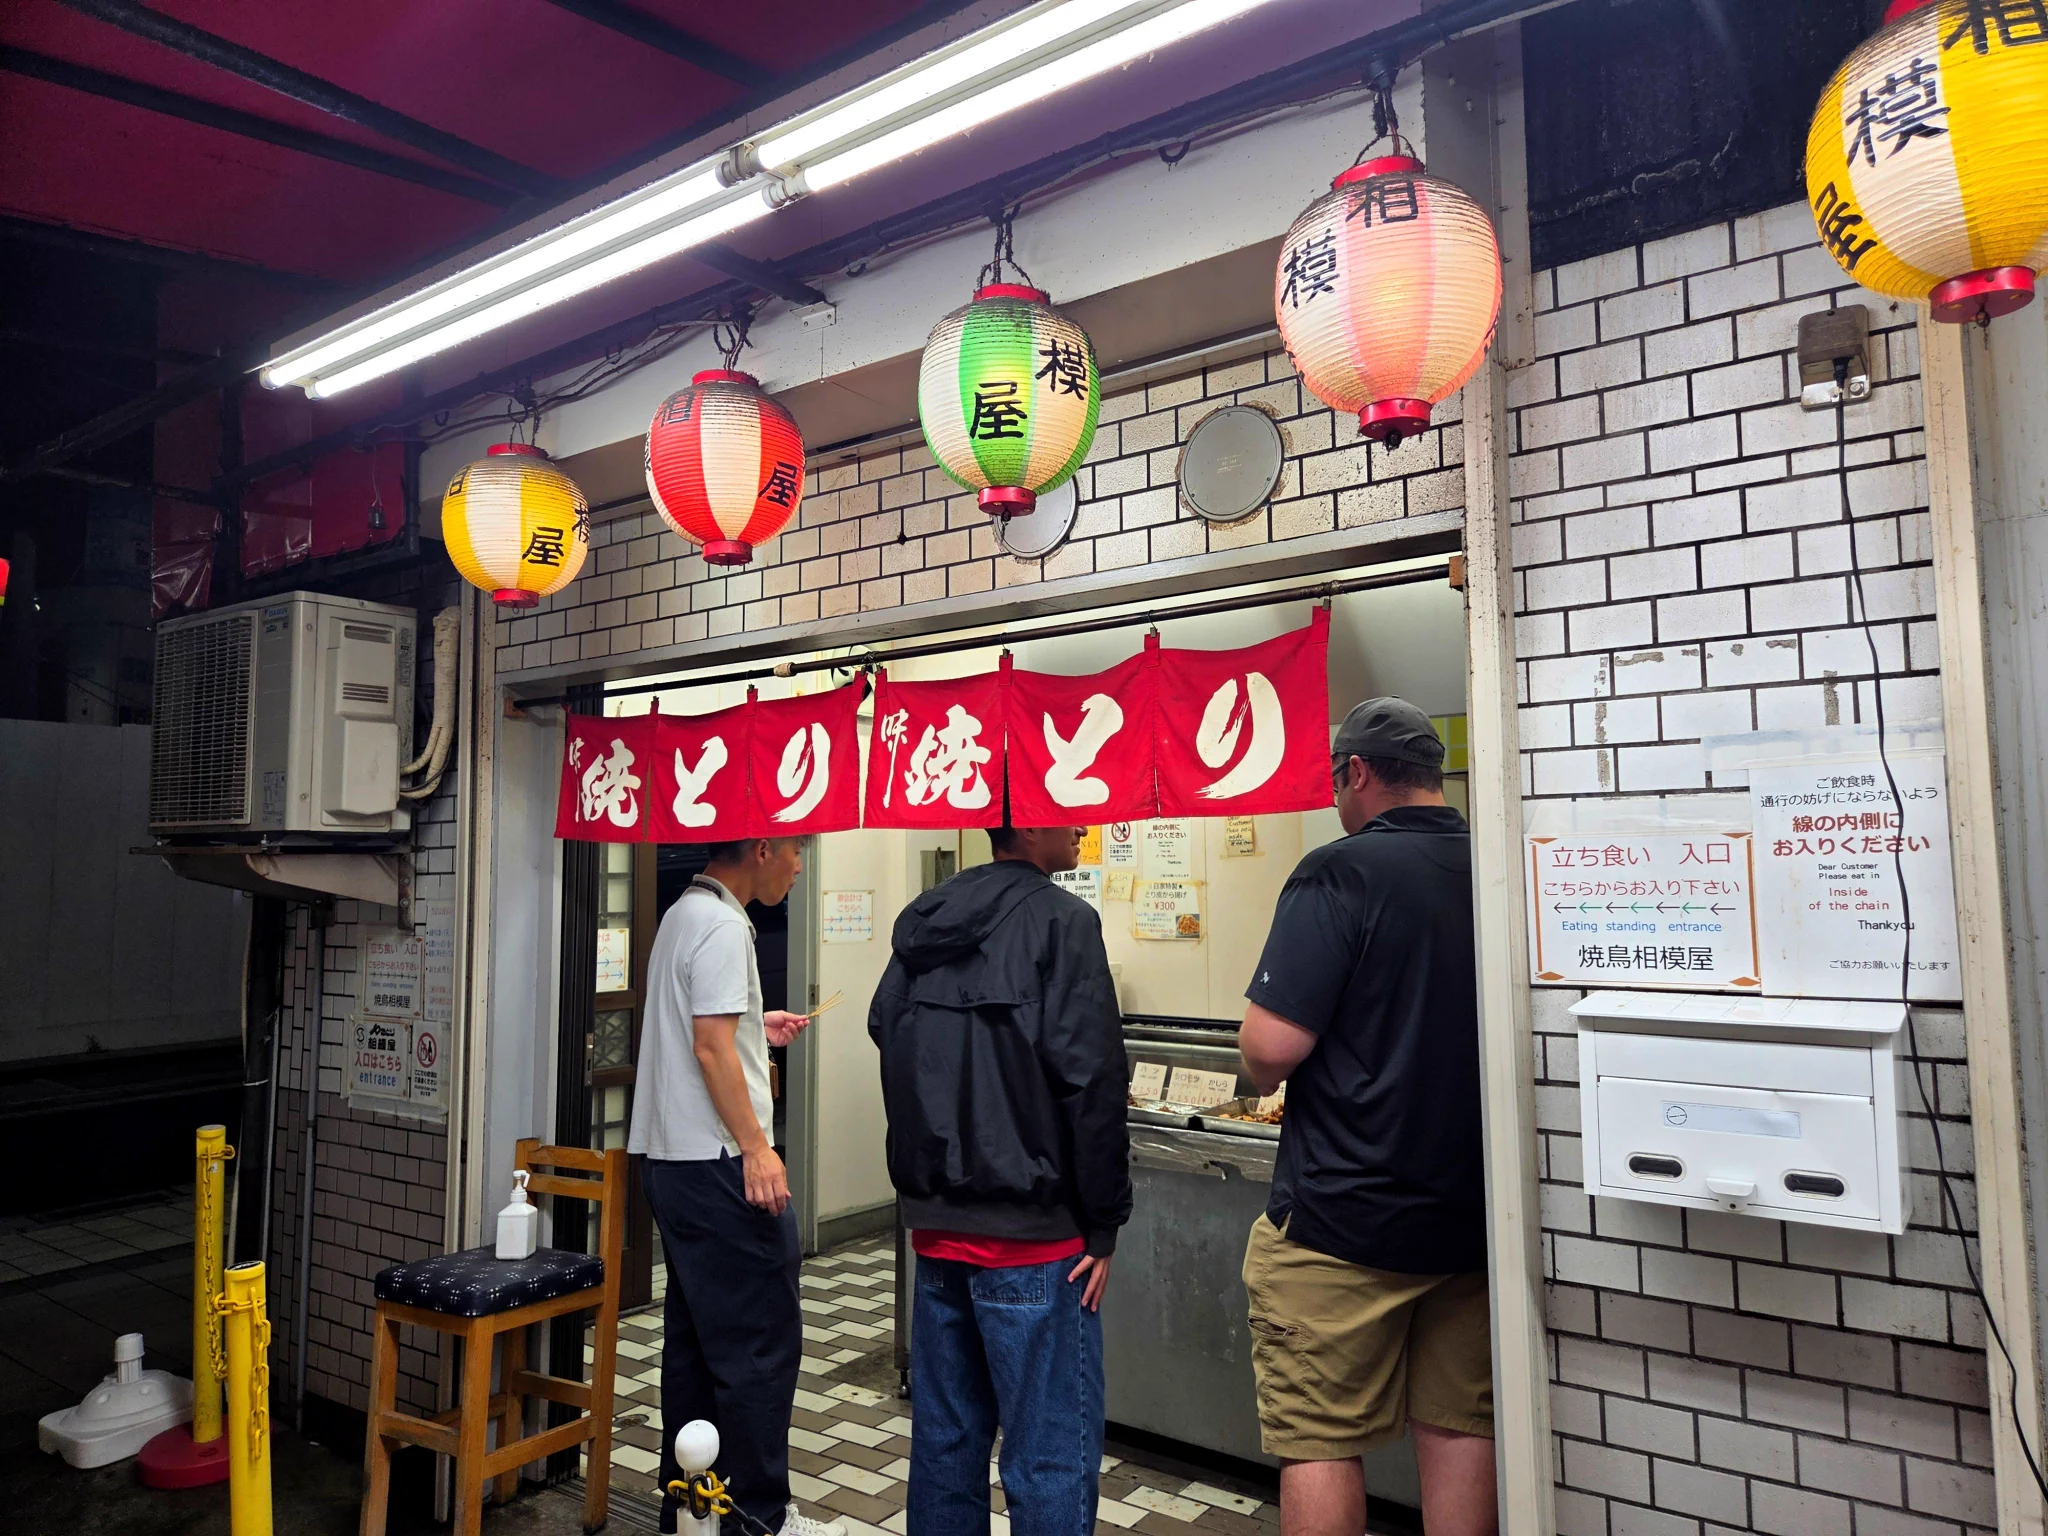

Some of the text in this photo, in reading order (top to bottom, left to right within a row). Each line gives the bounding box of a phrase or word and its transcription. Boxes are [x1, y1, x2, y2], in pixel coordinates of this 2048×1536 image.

[1816, 775, 1876, 789] ご飲食時
[1792, 811, 1903, 833] 線の内側に
[1773, 835, 1931, 857] お入りください
[1552, 843, 1731, 868] 立ち食い 入口
[1544, 879, 1740, 896] こちらからお入り下さい
[1829, 887, 1868, 897] Inside
[1808, 901, 1890, 910] of the chain
[1562, 921, 1722, 933] Eating standing entrance
[1578, 944, 1714, 971] 焼鳥相模屋
[354, 1051, 402, 1072] 入口はこちら
[359, 1071, 397, 1087] entrance
